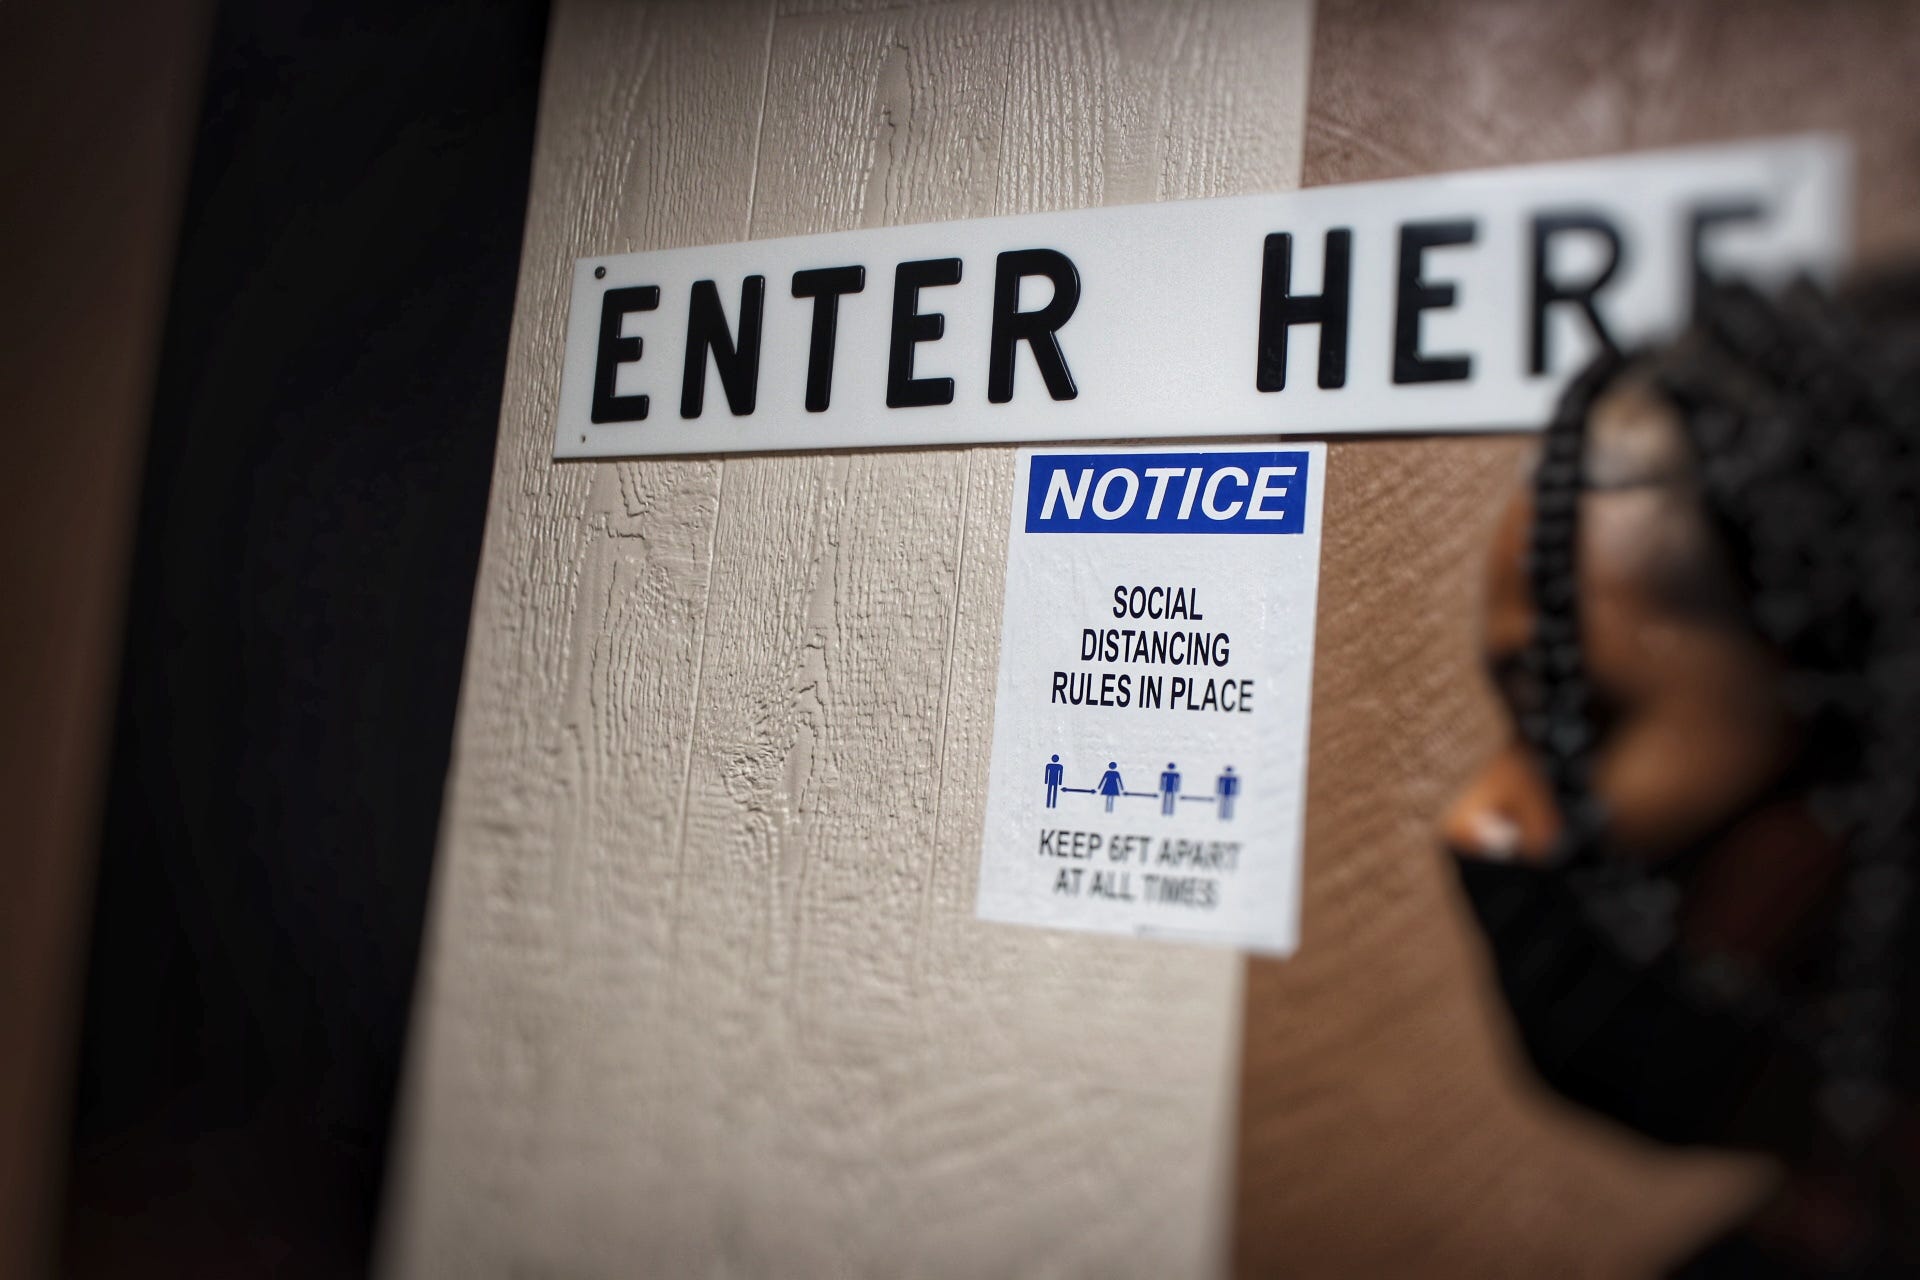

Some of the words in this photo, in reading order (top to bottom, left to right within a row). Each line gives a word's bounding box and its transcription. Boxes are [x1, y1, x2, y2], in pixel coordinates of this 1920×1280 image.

[590, 248, 1082, 424] ENTER
[1039, 466, 1298, 521] NOTICE
[1112, 585, 1203, 620] SOCIAL
[1080, 628, 1230, 667] DISTANCING
[1051, 671, 1131, 708] RULES
[1139, 675, 1163, 709] IN
[1170, 677, 1255, 712] PLACE
[1038, 828, 1104, 860] KEEP
[1107, 834, 1152, 864] 6FT
[1155, 838, 1244, 872] APART
[1053, 867, 1084, 896] AT
[1089, 869, 1136, 902] ALL
[1141, 873, 1220, 909] TIMES
